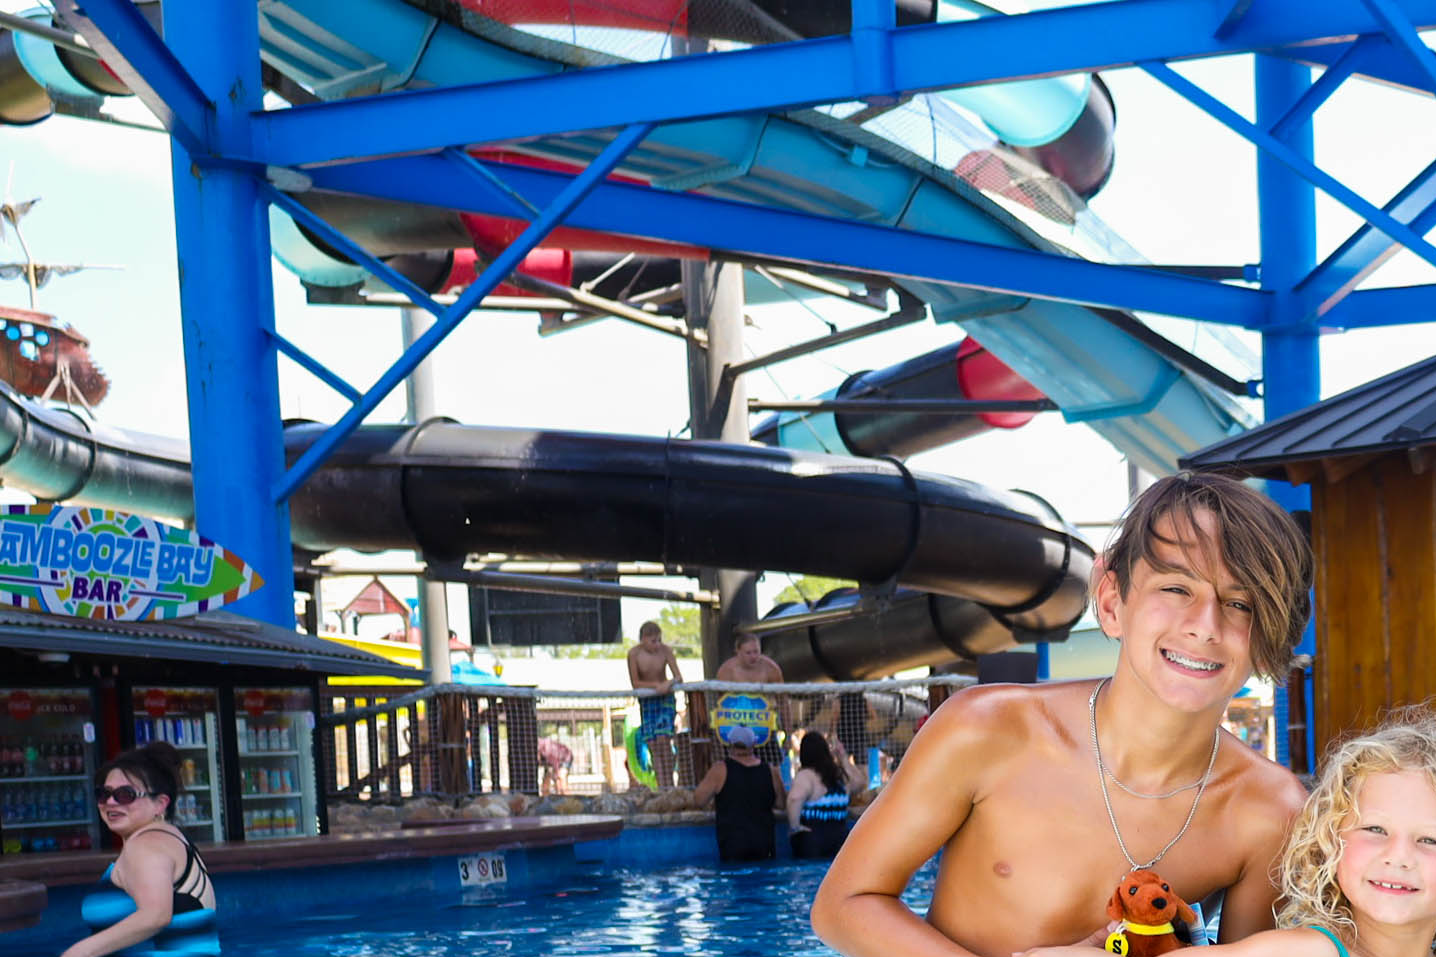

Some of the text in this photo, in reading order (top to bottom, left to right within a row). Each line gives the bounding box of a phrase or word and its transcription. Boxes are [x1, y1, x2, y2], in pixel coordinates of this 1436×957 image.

[157, 543, 215, 586] BAY
[72, 576, 122, 601] BAR
[717, 711, 769, 720] PROTECT
[1112, 939, 1122, 955] S
